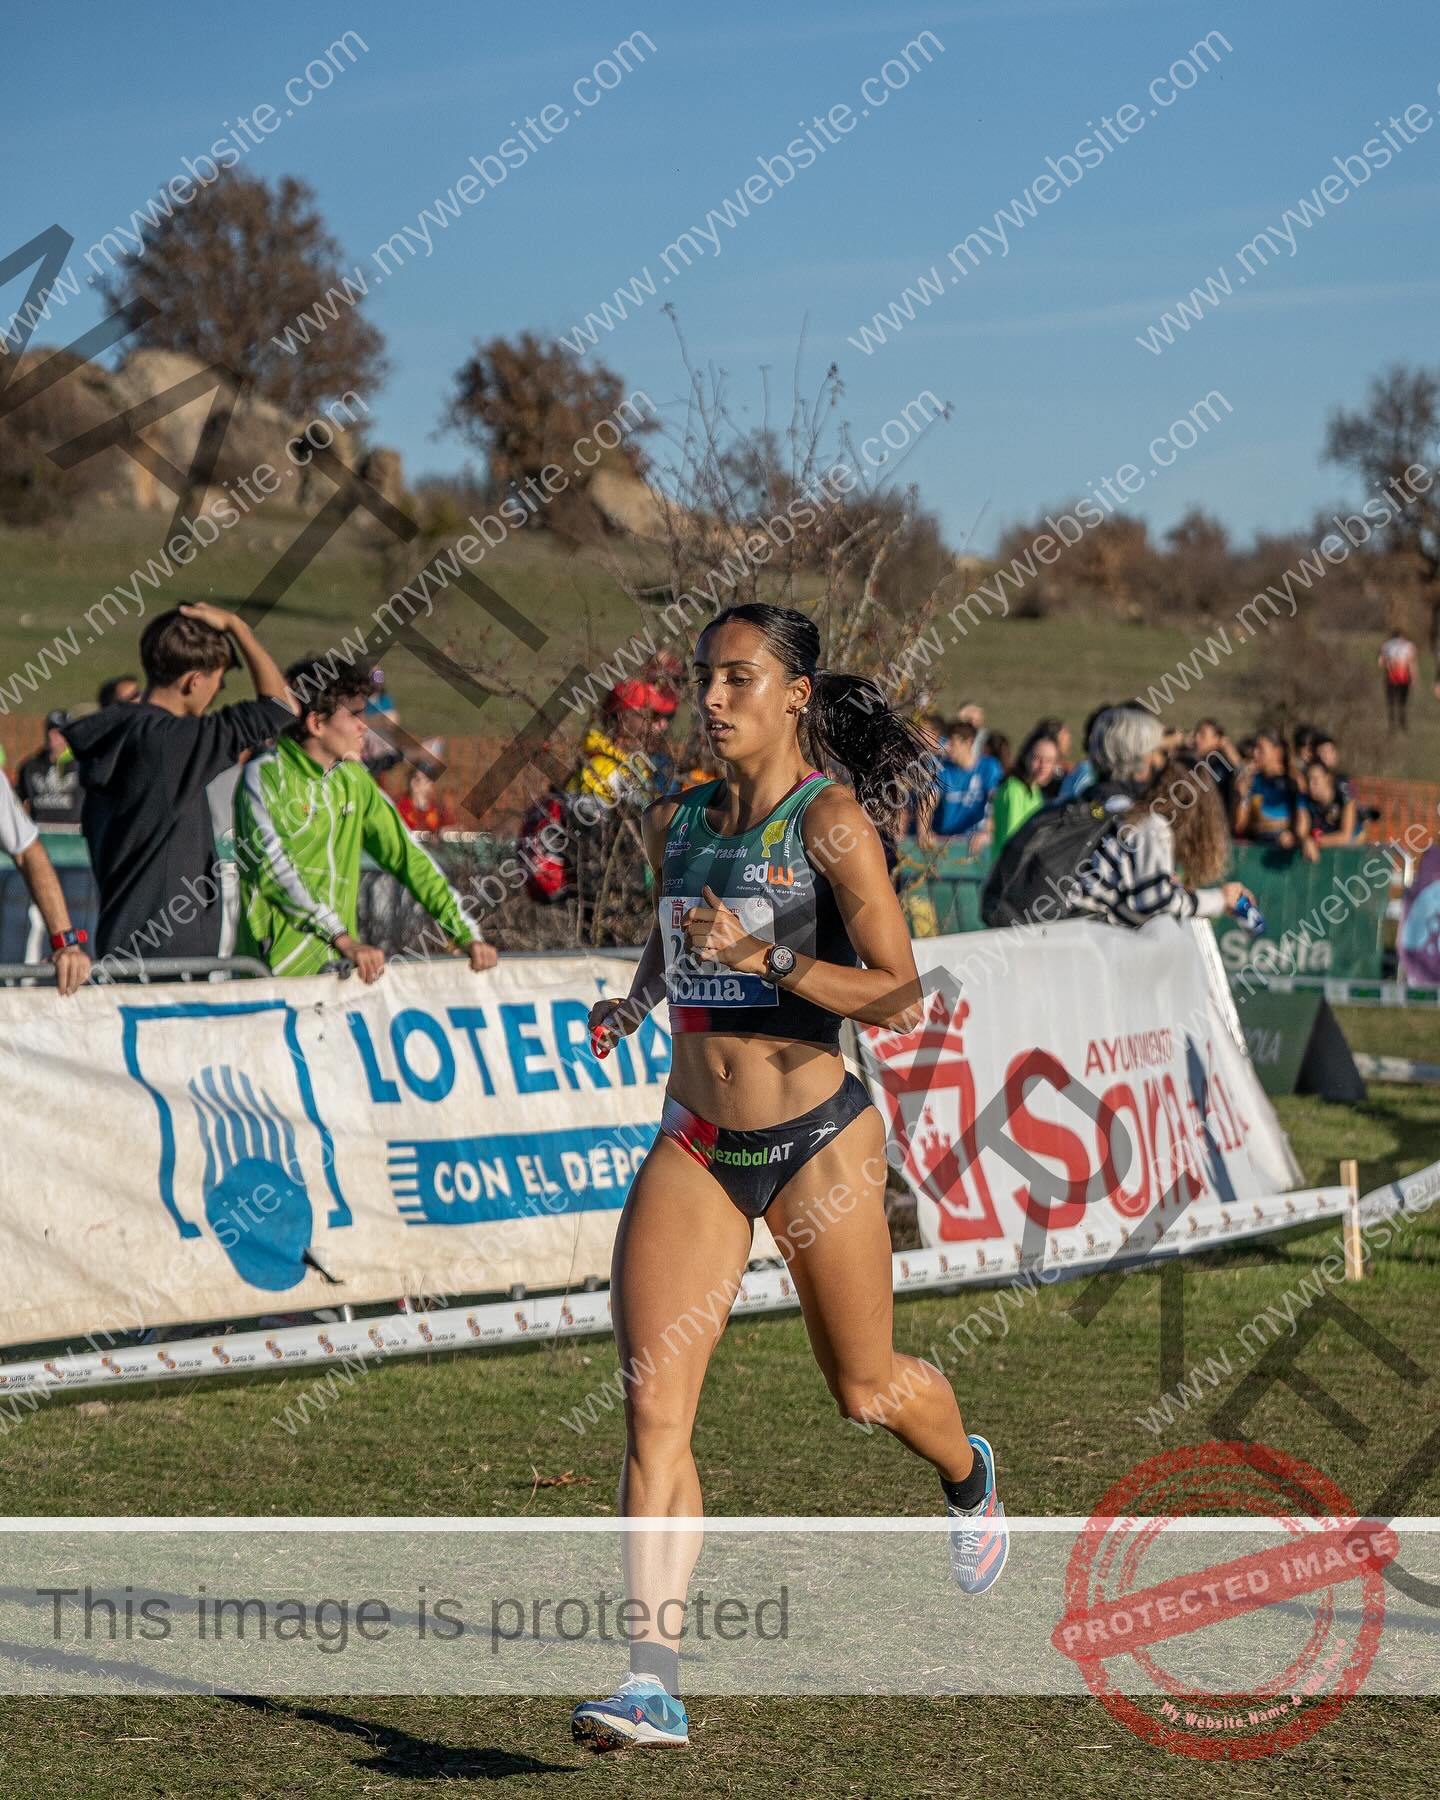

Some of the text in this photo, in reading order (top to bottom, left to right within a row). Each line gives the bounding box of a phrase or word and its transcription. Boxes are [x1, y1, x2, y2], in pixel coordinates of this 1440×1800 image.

[1220, 928, 1333, 971] Soria
[433, 1156, 512, 1204] CON
[515, 1154, 558, 1195] EL
